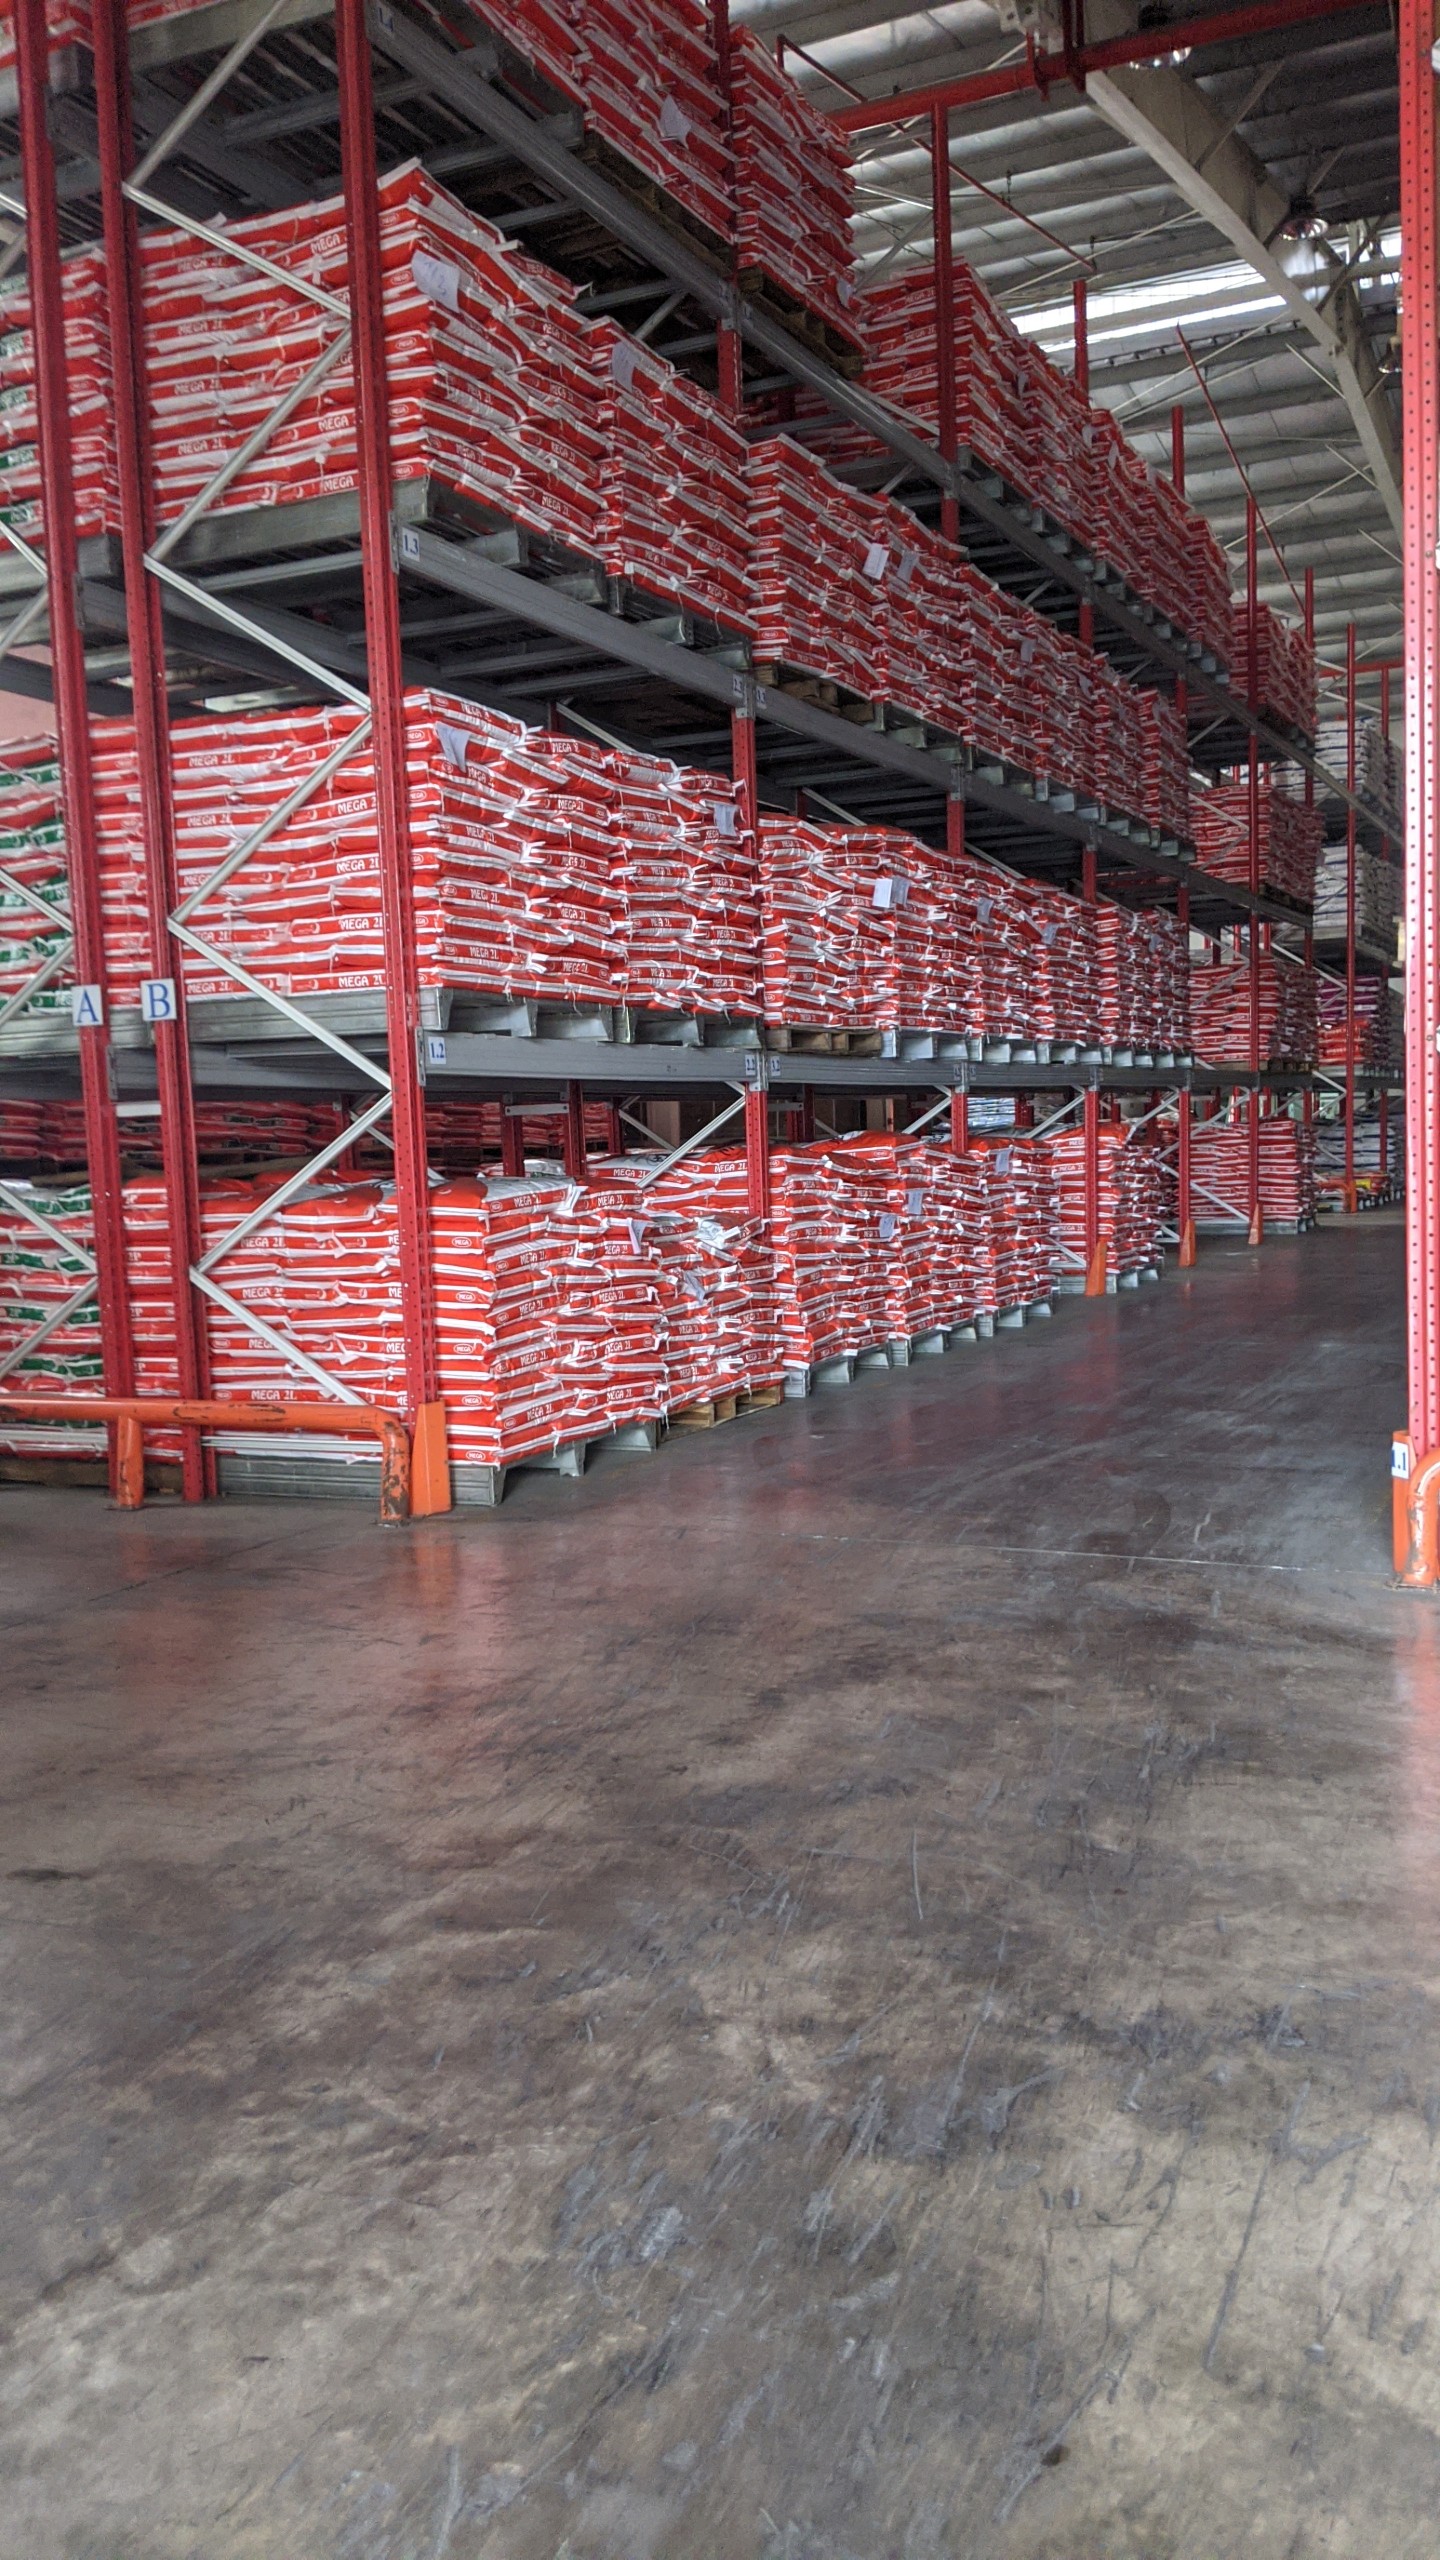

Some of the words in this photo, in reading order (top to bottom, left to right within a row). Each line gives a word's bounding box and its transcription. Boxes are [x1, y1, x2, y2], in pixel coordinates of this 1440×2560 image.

[318, 415, 349, 432] MEGA
[322, 475, 354, 492] MEGA
[189, 754, 218, 767] MEGA
[337, 799, 367, 815] MEGA
[187, 814, 217, 827] MEGA
[336, 860, 365, 874] MEGA
[340, 918, 369, 930] MEGA
[470, 946, 488, 958] MEGA
[489, 950, 499, 960] 2L
[338, 976, 368, 987] MEGA
[373, 975, 386, 985] 2L
[187, 981, 217, 994] MEGA
[76, 988, 99, 1024] A
[146, 983, 171, 1019] B
[430, 1042, 445, 1059] 1.2
[613, 1168, 637, 1178] MEGA
[714, 1163, 737, 1173] MEGA
[514, 1195, 533, 1208] MEGA
[240, 1237, 269, 1248] MEGA
[453, 1238, 470, 1247] MEGA
[242, 1288, 271, 1299] MEGA
[457, 1293, 474, 1302] MEGA
[599, 1291, 617, 1303] MEGA
[617, 1290, 626, 1301] 2L
[386, 1342, 406, 1352] MEG
[456, 1345, 471, 1353] MEGA
[605, 1342, 623, 1354] MEGA
[251, 1390, 280, 1401] MEGA
[284, 1390, 298, 1400] 2L
[464, 1396, 480, 1405] MEGA
[606, 1390, 624, 1401] MEGA
[526, 1406, 545, 1420] MEGA
[468, 1452, 484, 1461] MEGA
